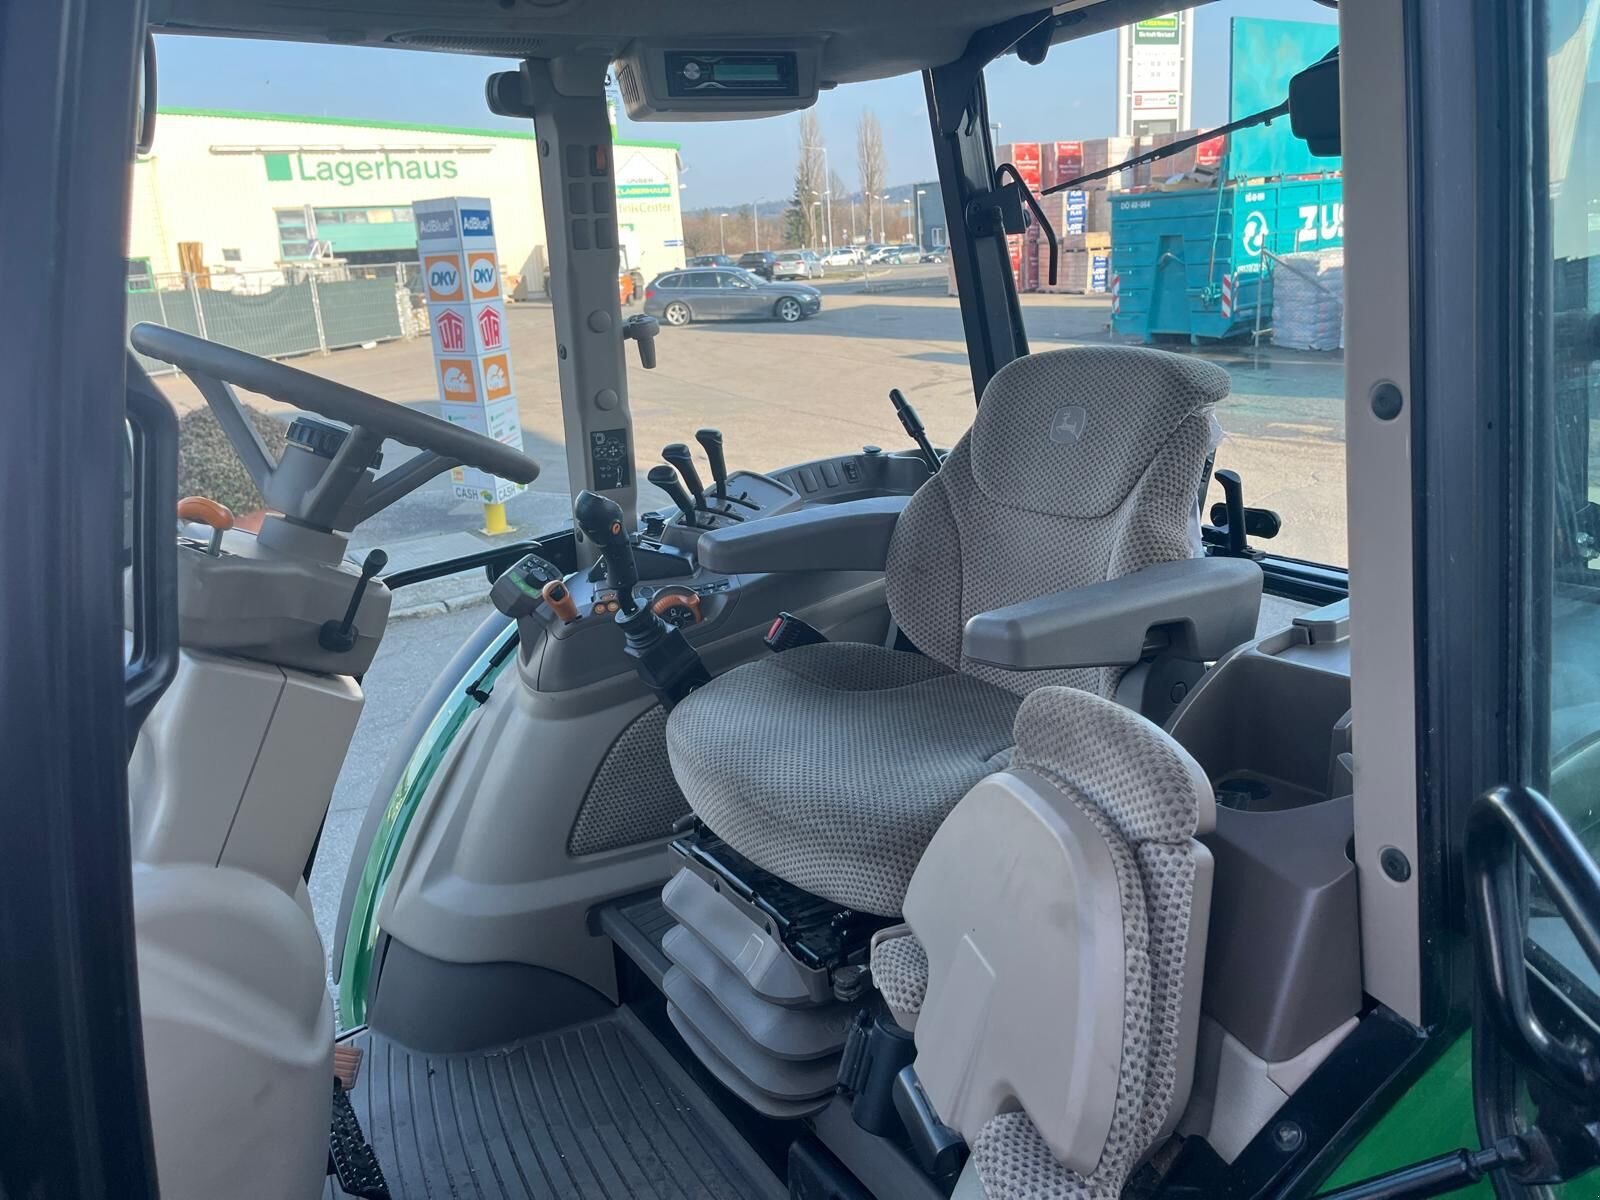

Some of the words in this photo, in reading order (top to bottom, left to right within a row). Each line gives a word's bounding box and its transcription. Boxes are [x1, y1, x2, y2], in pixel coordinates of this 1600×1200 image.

[298, 153, 458, 186] Lagerhaus
[431, 271, 457, 287] DKV
[473, 268, 493, 284] DKV
[455, 487, 479, 500] CASH
[498, 483, 516, 501] CASH
